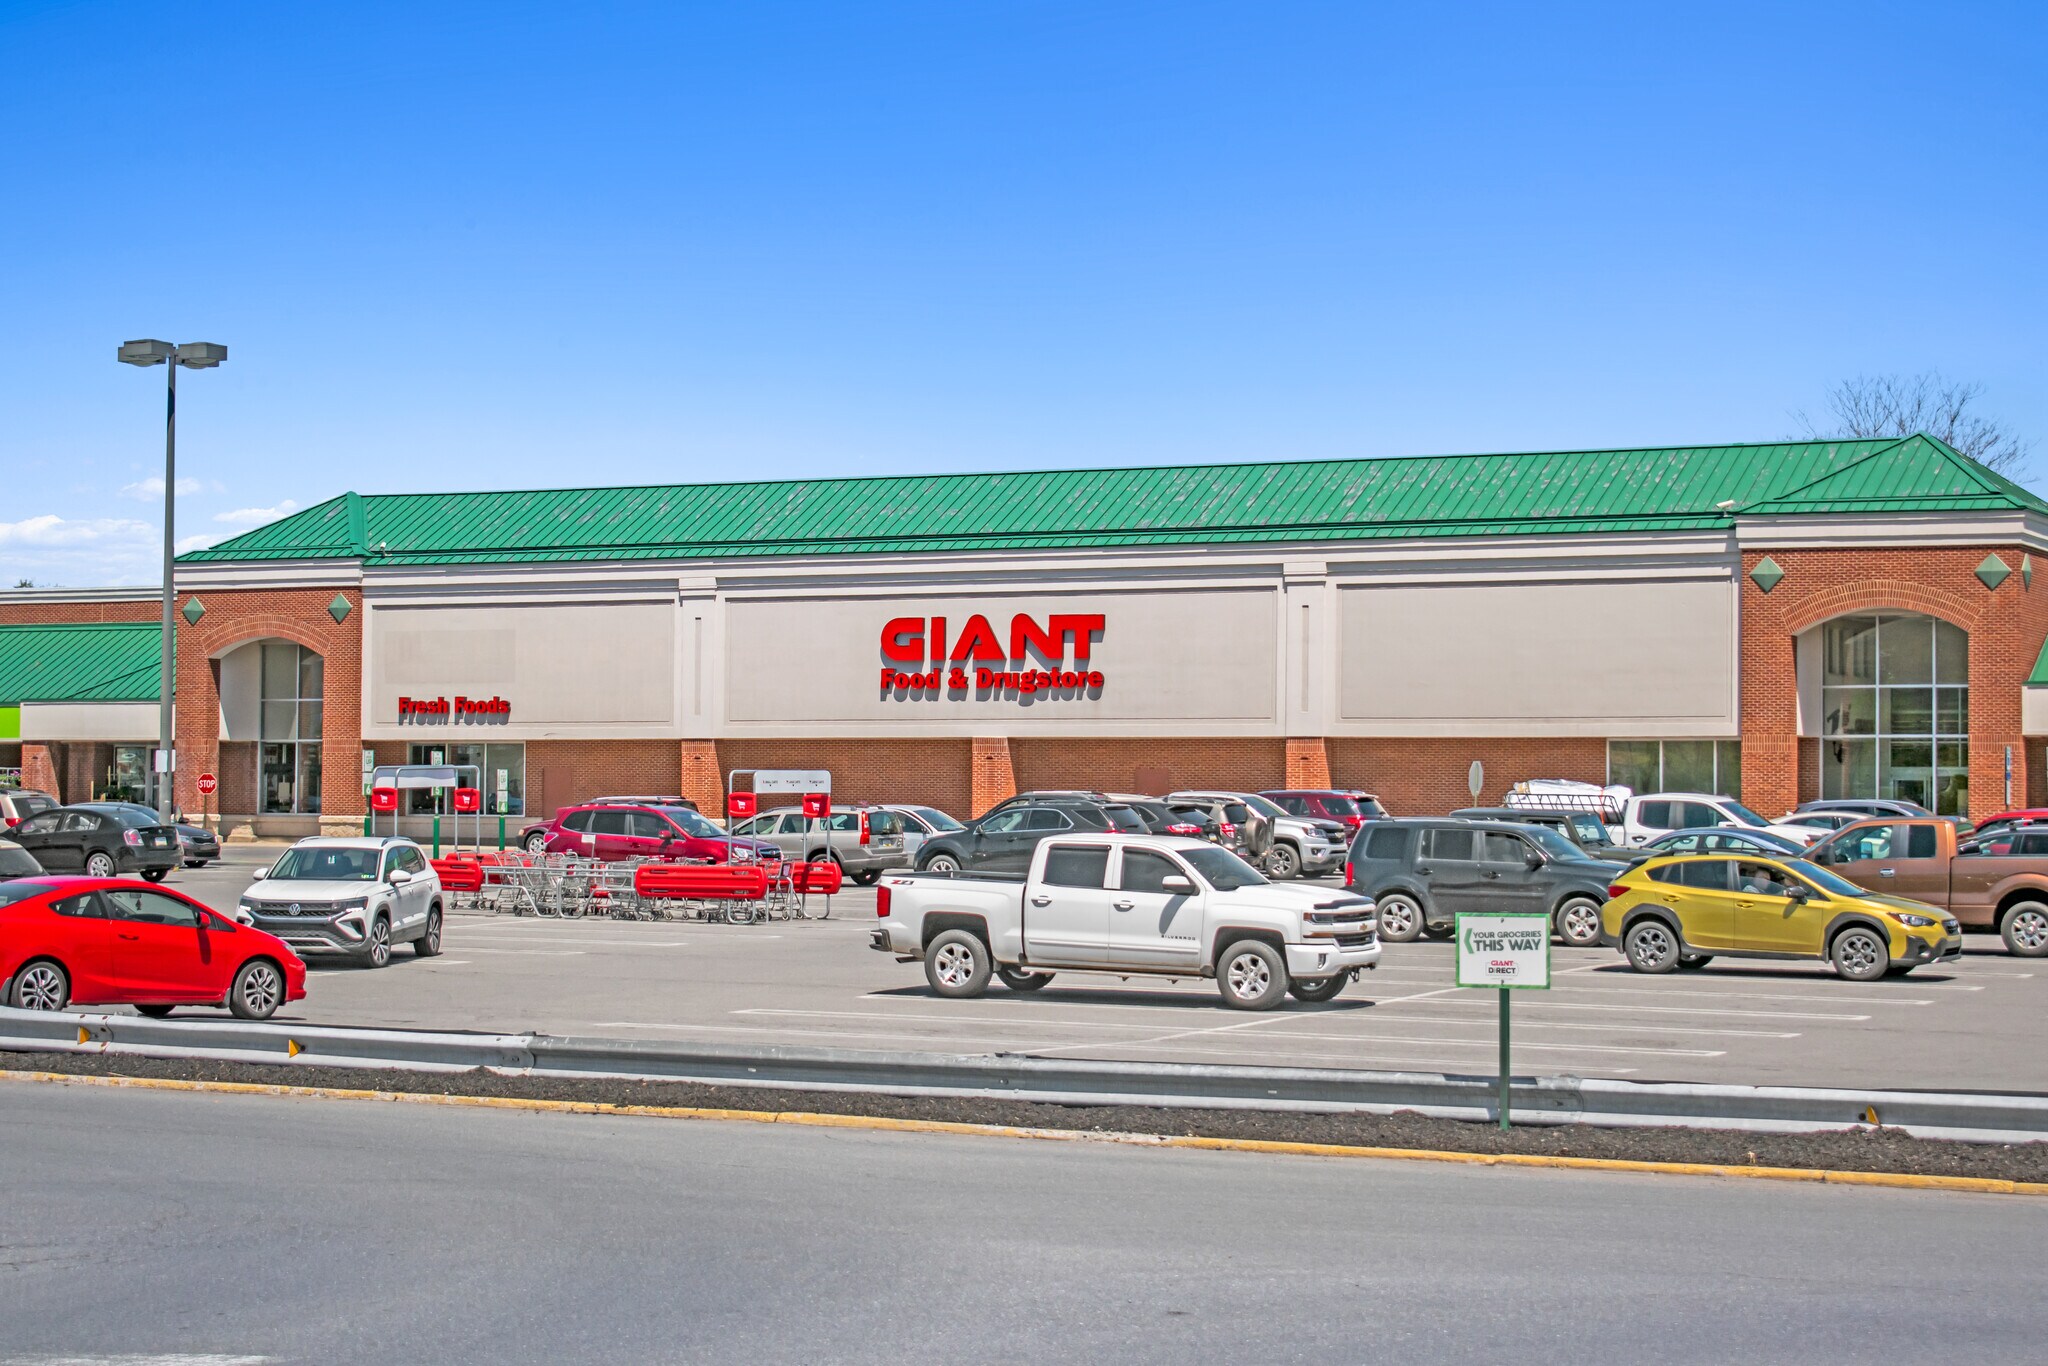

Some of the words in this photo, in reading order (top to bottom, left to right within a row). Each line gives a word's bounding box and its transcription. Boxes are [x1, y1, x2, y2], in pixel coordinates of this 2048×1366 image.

[881, 613, 1105, 661] GIANT
[881, 668, 941, 690] Food
[948, 667, 968, 689] &
[976, 667, 1104, 694] Drugstore
[398, 697, 449, 714] Fresh
[454, 696, 510, 714] Foods
[199, 780, 216, 788] STOP
[1473, 940, 1504, 951] THIS
[1508, 939, 1541, 950] WAY
